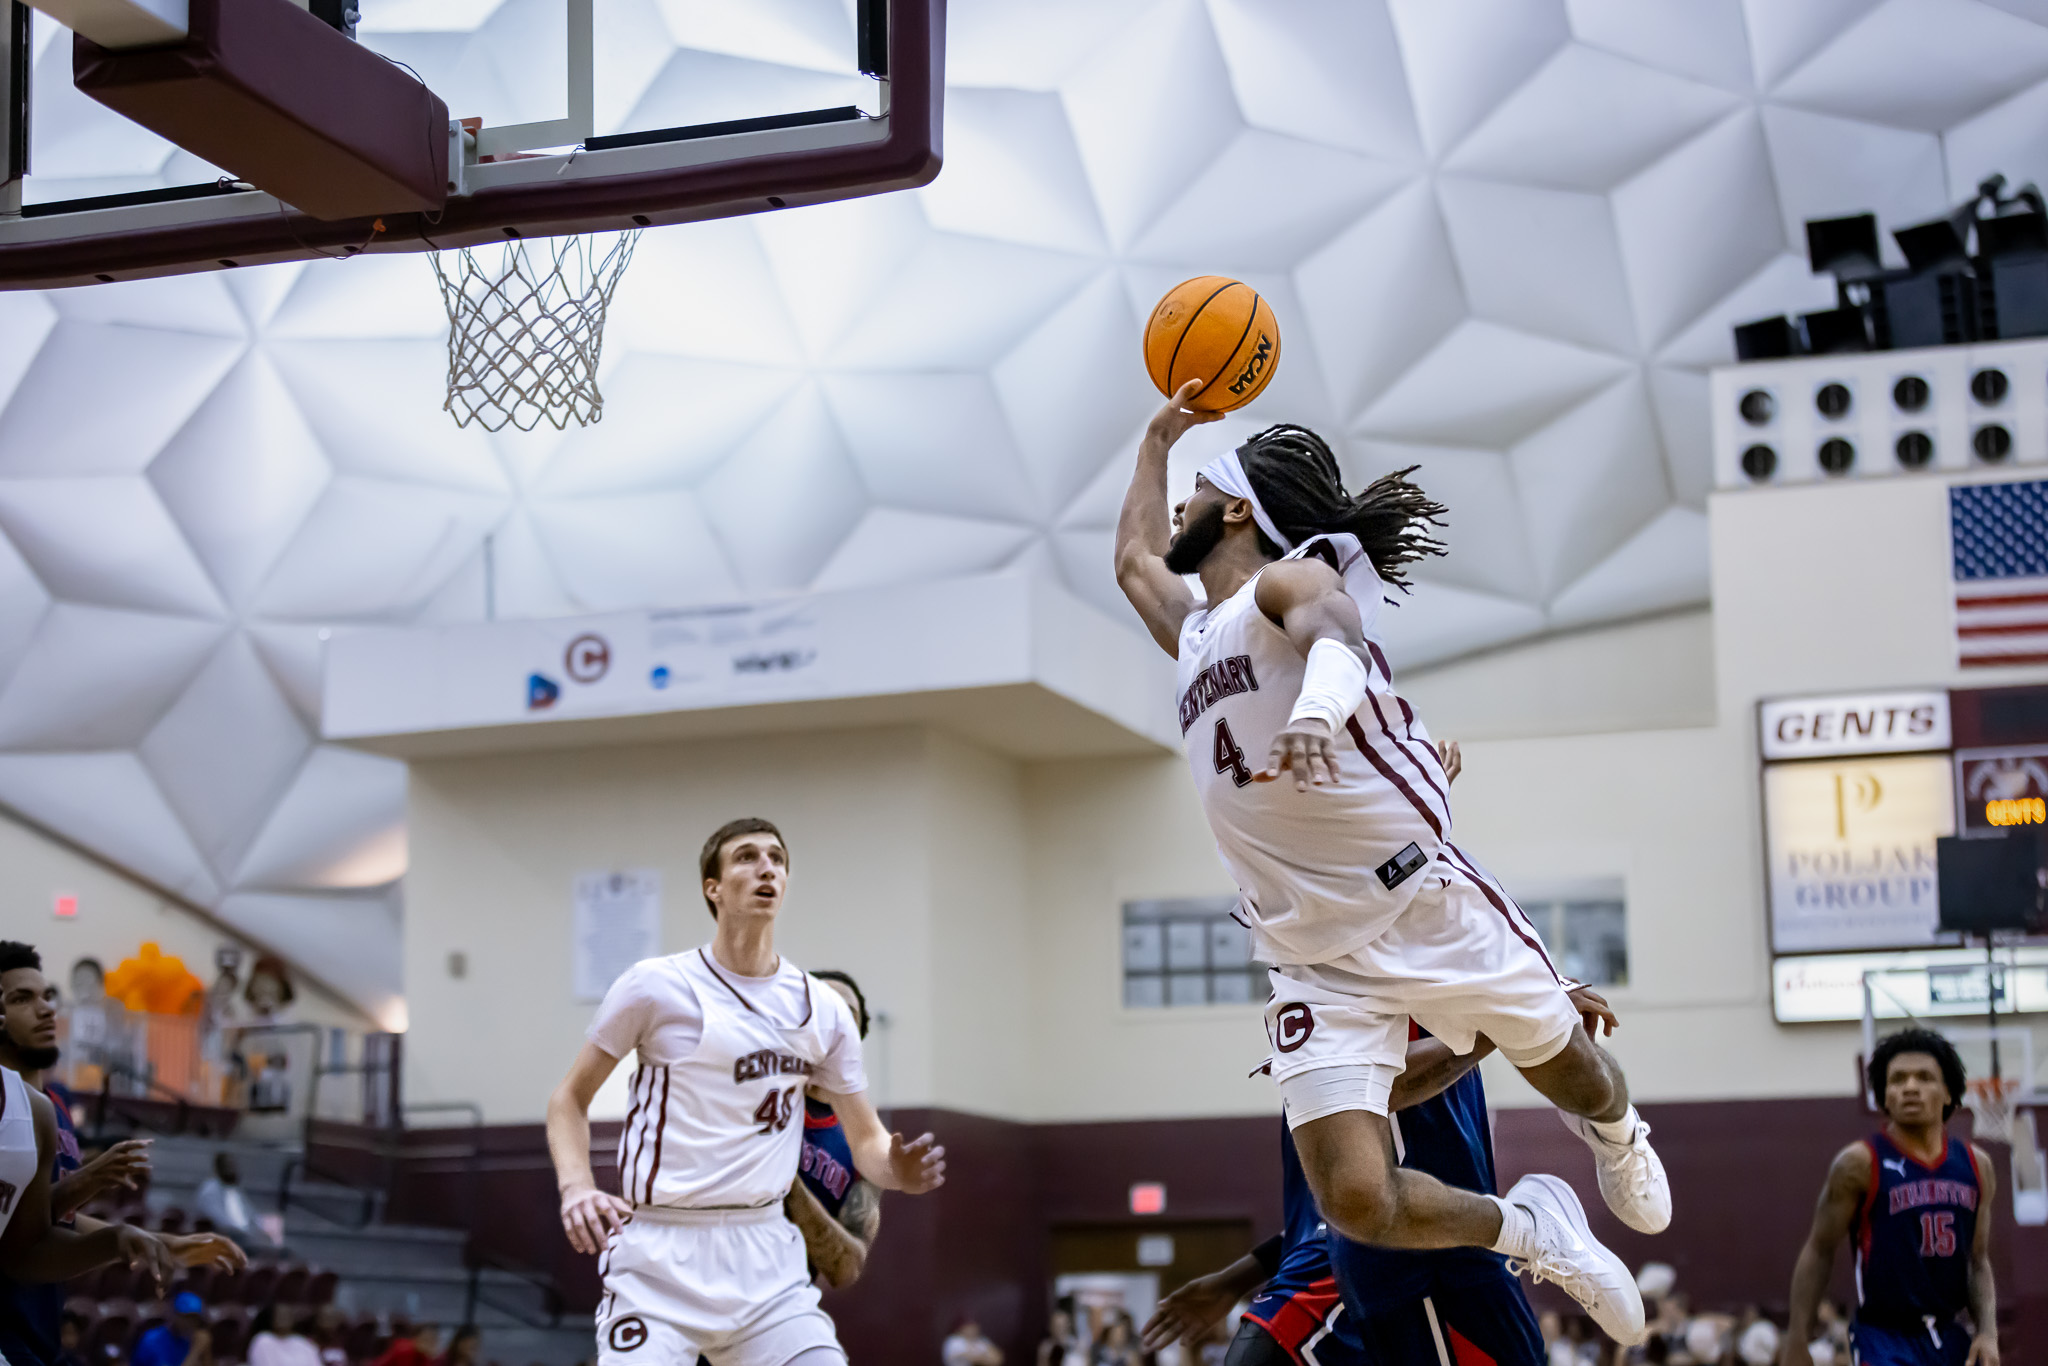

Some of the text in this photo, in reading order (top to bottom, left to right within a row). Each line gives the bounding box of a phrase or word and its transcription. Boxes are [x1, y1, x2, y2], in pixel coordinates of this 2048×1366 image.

[1228, 334, 1272, 394] NCAA
[1179, 655, 1259, 738] CENTENARY
[1775, 705, 1936, 743] GENTS
[1213, 717, 1253, 788] 4
[1795, 876, 1932, 909] GROUP
[1279, 1008, 1307, 1048] C
[1920, 1210, 1956, 1257] 15
[613, 1320, 643, 1350] C
